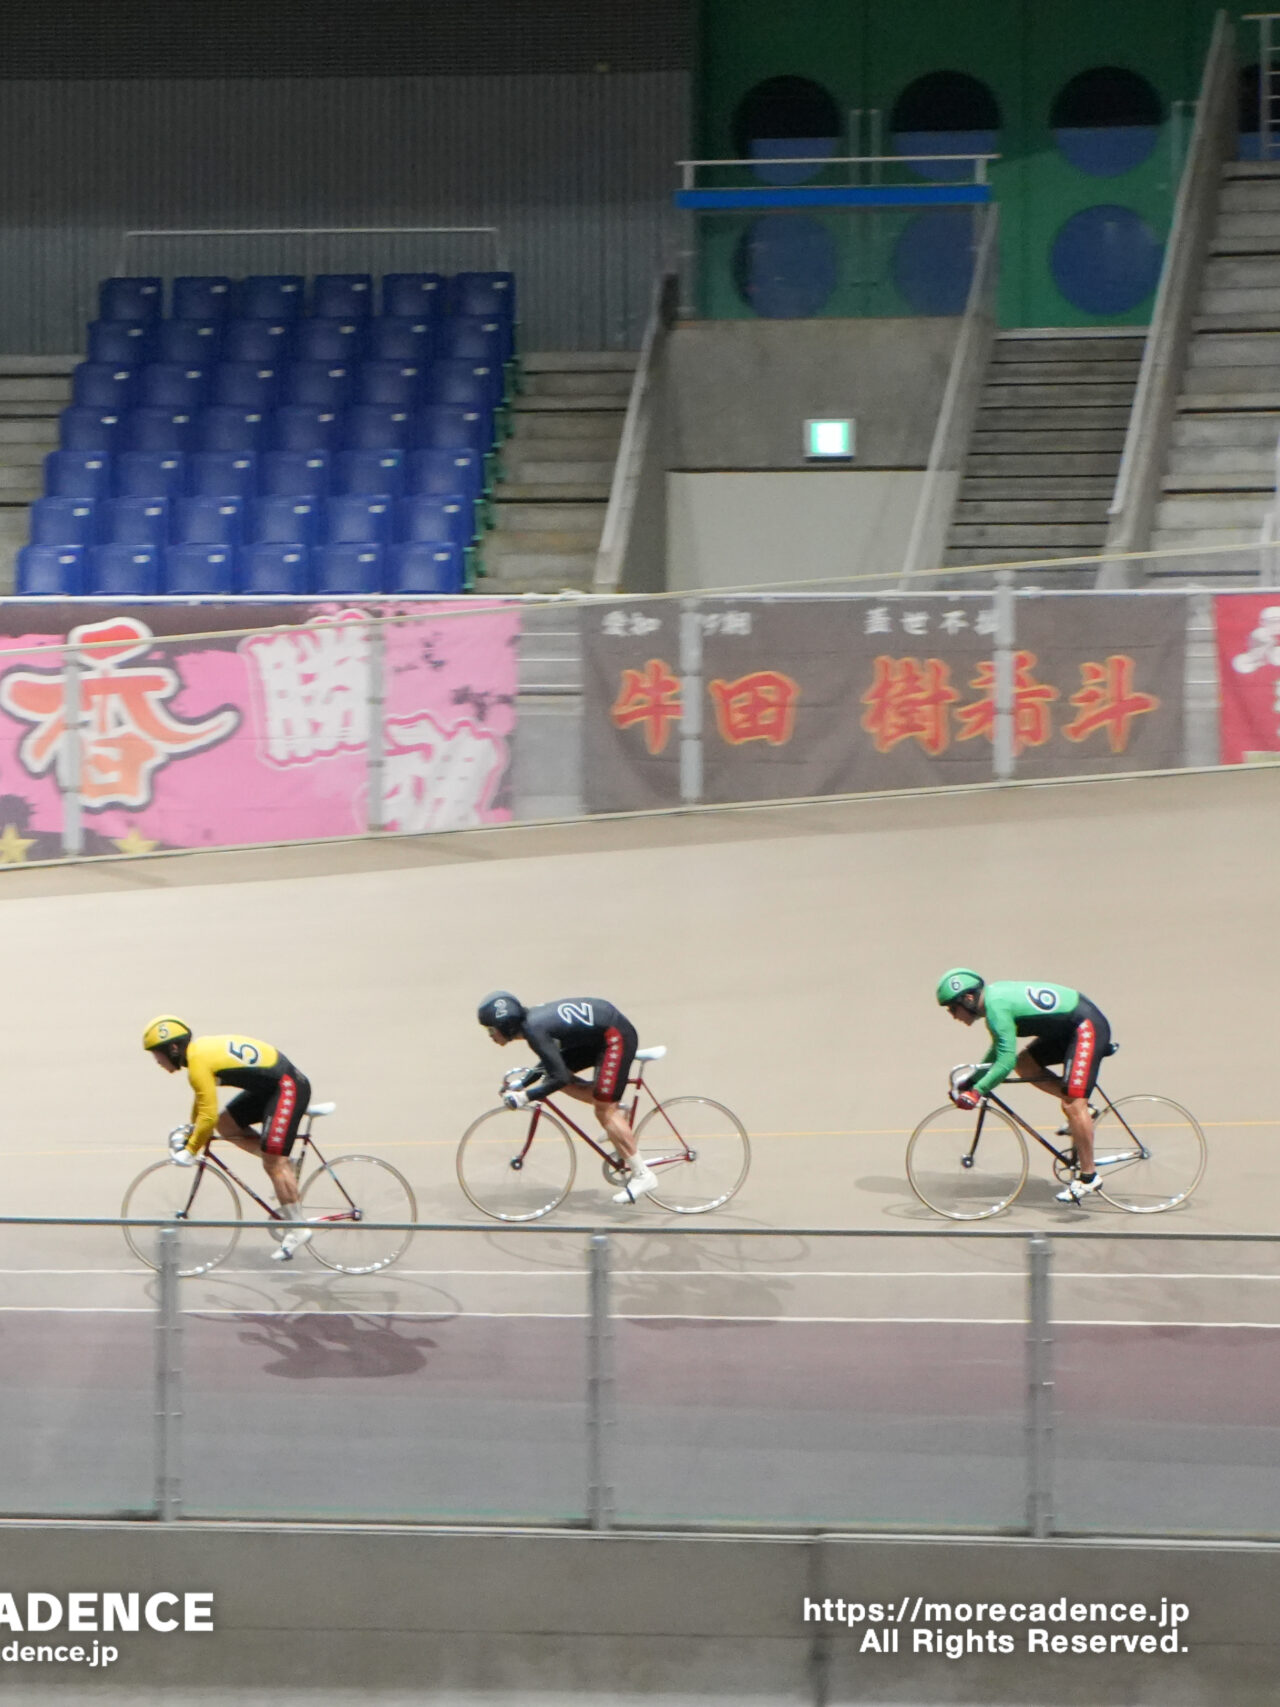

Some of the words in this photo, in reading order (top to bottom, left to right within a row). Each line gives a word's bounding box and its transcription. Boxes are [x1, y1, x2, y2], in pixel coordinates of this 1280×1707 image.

[612, 658, 799, 755] 牛田
[950, 977, 963, 994] 6
[1027, 986, 1059, 1013] 6
[557, 1002, 595, 1026] 2
[157, 1023, 170, 1040] 5
[228, 1039, 261, 1066] 5
